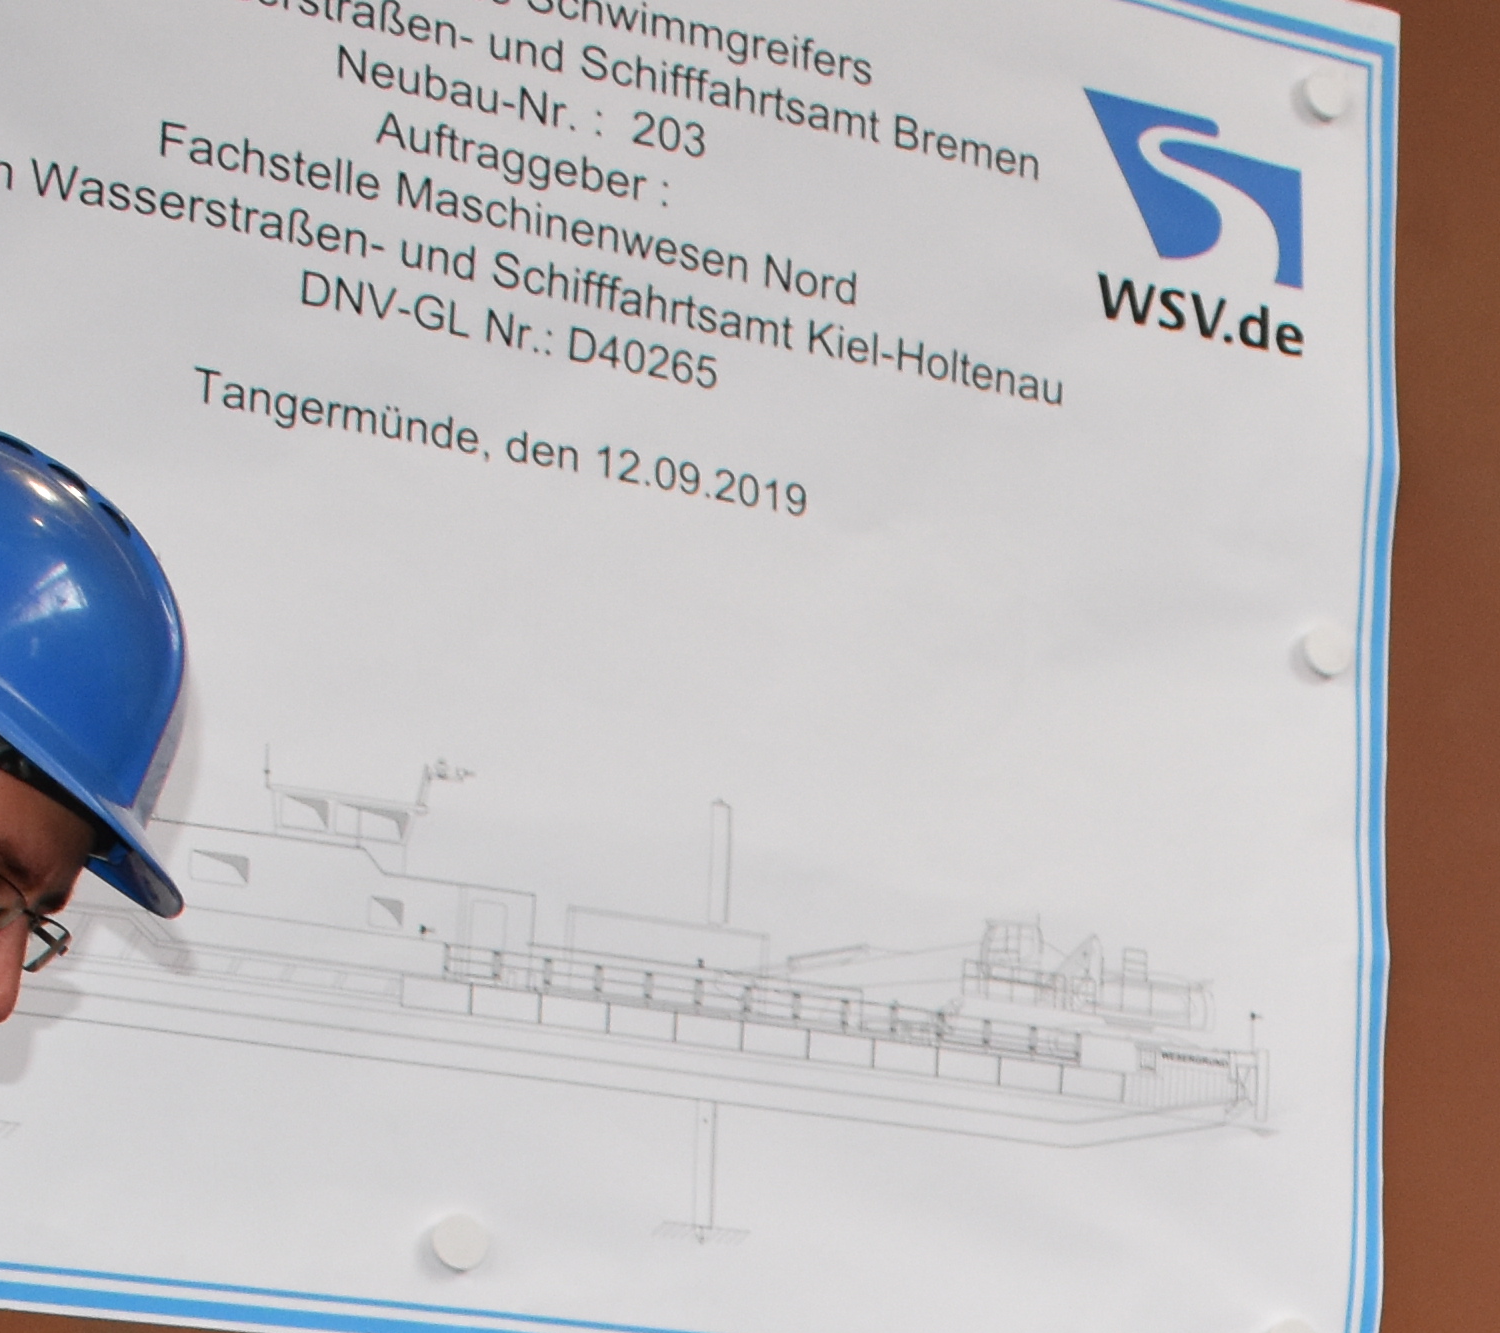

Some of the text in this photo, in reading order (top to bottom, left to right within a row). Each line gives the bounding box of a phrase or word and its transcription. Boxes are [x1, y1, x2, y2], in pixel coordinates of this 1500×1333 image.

[375, 111, 648, 201] Auftraggeber
[489, 32, 564, 74] und
[580, 44, 880, 144] Schifffahrtsamt
[893, 113, 1039, 181] Bremen
[631, 110, 706, 159] 203
[159, 119, 858, 306] Fachstelle Maschinenwesen Nord
[30, 157, 386, 259] Wasserstraßen-
[400, 239, 477, 282] und
[492, 251, 794, 351] Schifffahrtsamt
[807, 319, 1063, 407] Kiel-Holtenau
[300, 269, 718, 390] DNV-GL Nr.: D40265
[1097, 271, 1305, 358] WSV.de
[193, 365, 807, 517] Tangermünde, den 12.09.2019
